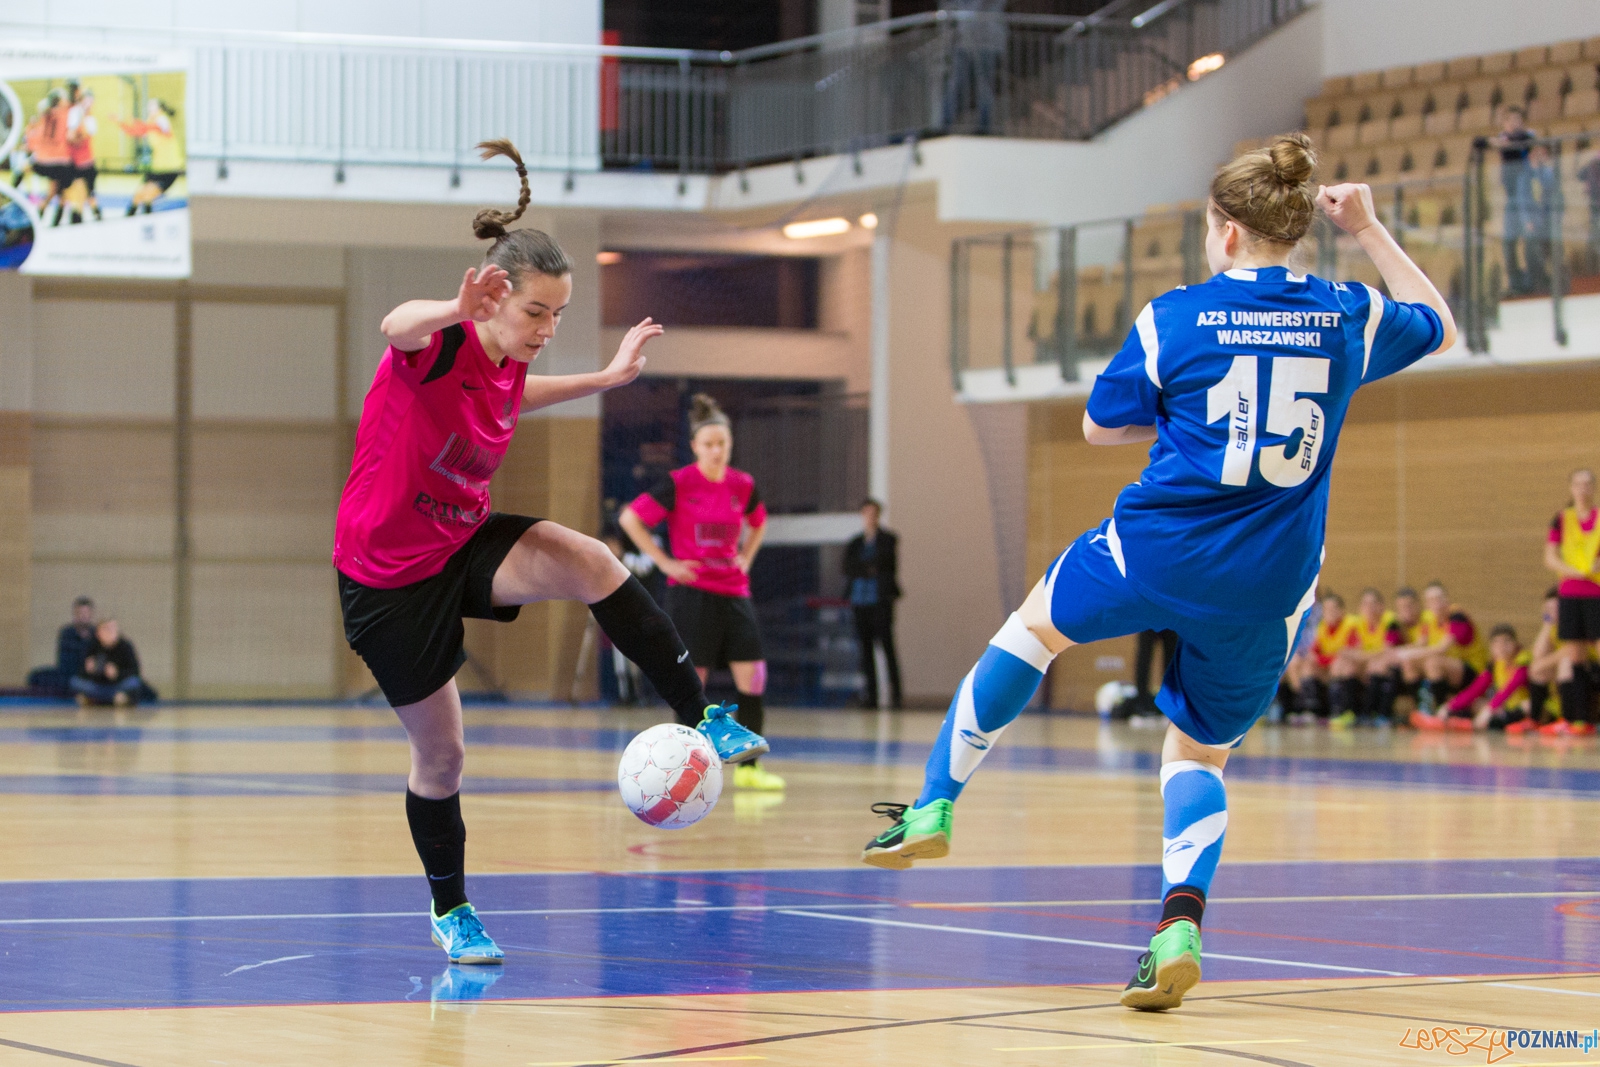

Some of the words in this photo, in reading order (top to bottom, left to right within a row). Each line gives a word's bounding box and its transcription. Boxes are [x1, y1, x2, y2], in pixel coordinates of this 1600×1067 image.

[1196, 311, 1227, 327] AZS
[1231, 311, 1341, 328] UNIWERSYTET
[1216, 330, 1321, 347] WARSZAWSKI
[1206, 355, 1331, 488] 15
[1235, 390, 1249, 452] saller
[1301, 408, 1320, 472] saller
